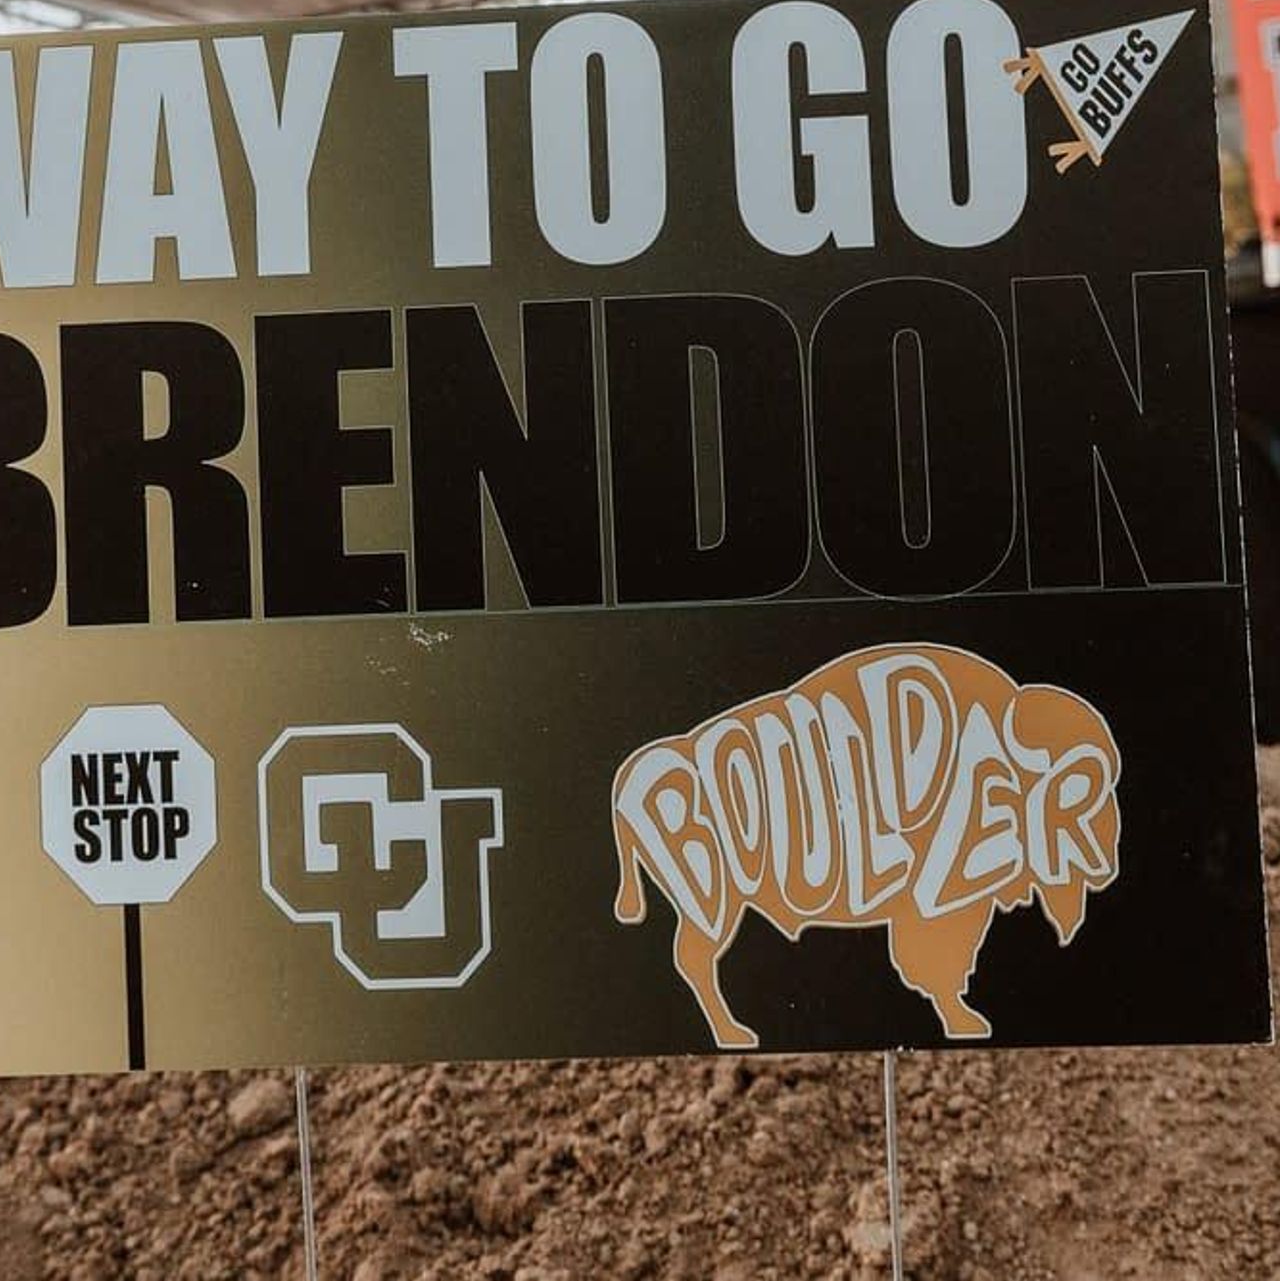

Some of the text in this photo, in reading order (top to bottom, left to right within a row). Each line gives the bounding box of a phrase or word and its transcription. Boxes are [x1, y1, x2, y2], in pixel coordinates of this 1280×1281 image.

[1060, 43, 1100, 93] GO
[1078, 28, 1159, 139] BUFFS
[392, 11, 667, 266] TO
[71, 750, 179, 807] NEXT
[615, 654, 1112, 942] BOULDER
[73, 807, 190, 864] STOP
